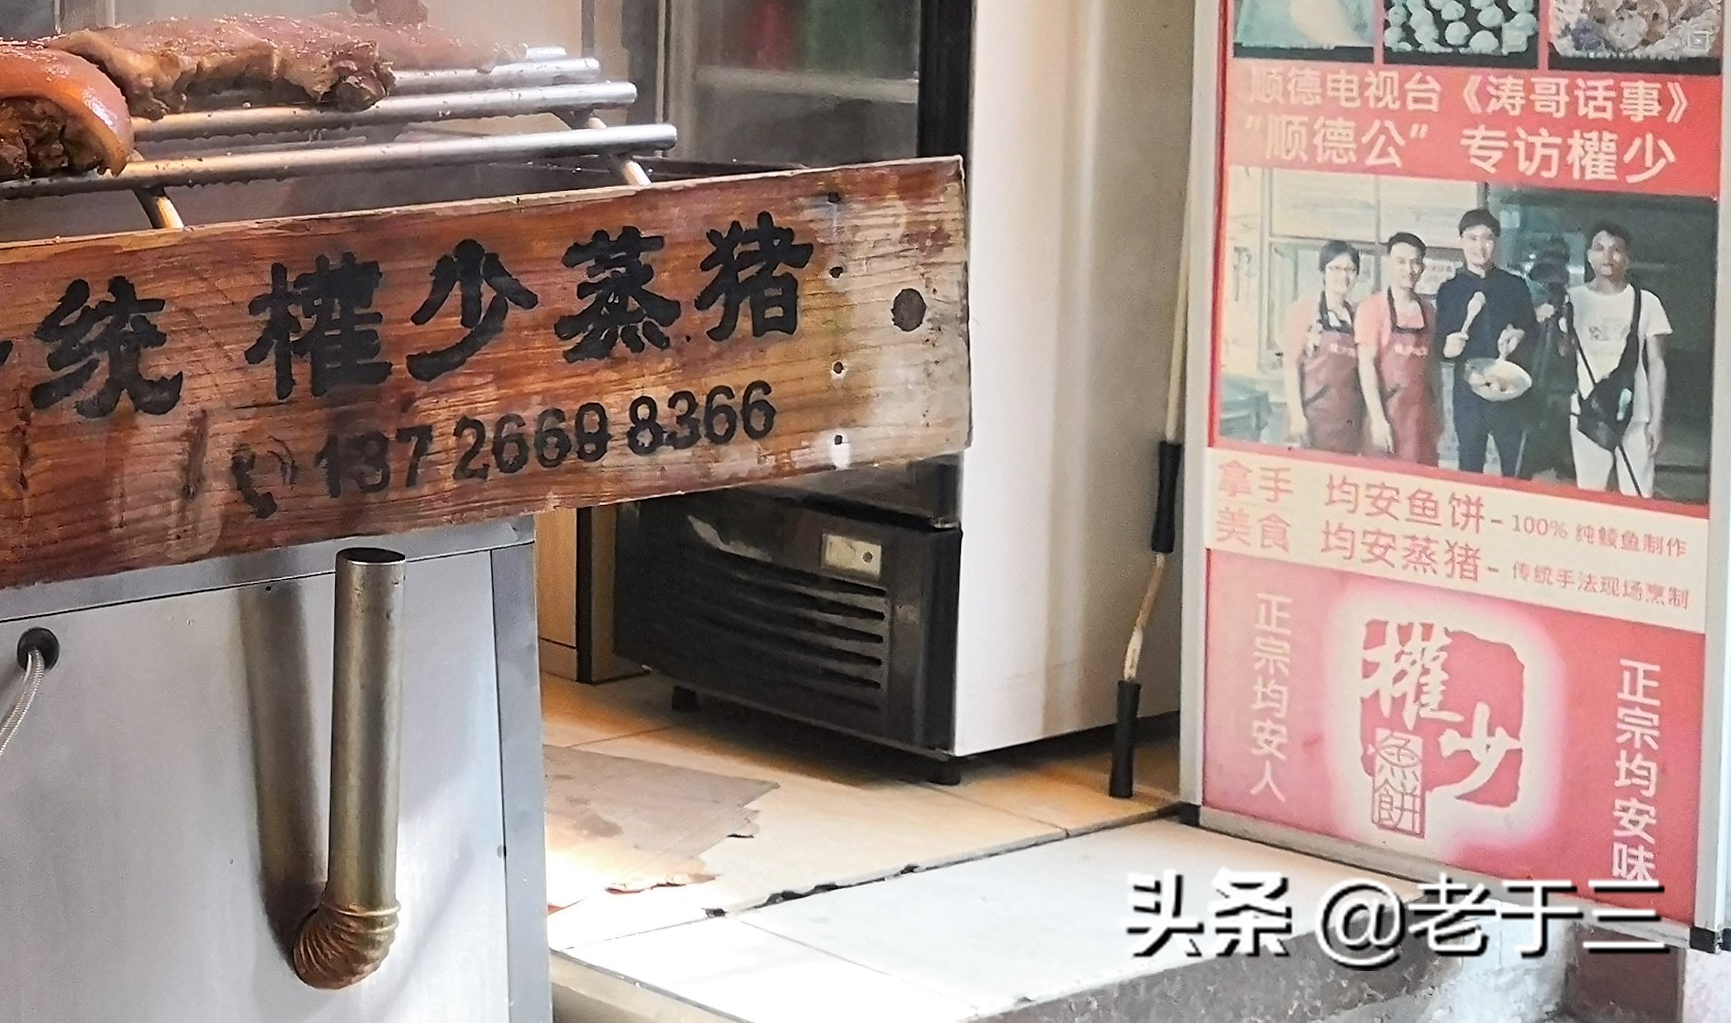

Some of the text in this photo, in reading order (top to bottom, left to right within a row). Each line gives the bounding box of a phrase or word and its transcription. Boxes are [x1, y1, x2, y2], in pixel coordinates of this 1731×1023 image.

[1215, 506, 1292, 553] 美食
[1249, 592, 1293, 803] 正宗均安人
[1611, 658, 1661, 881] 正宗均安味
